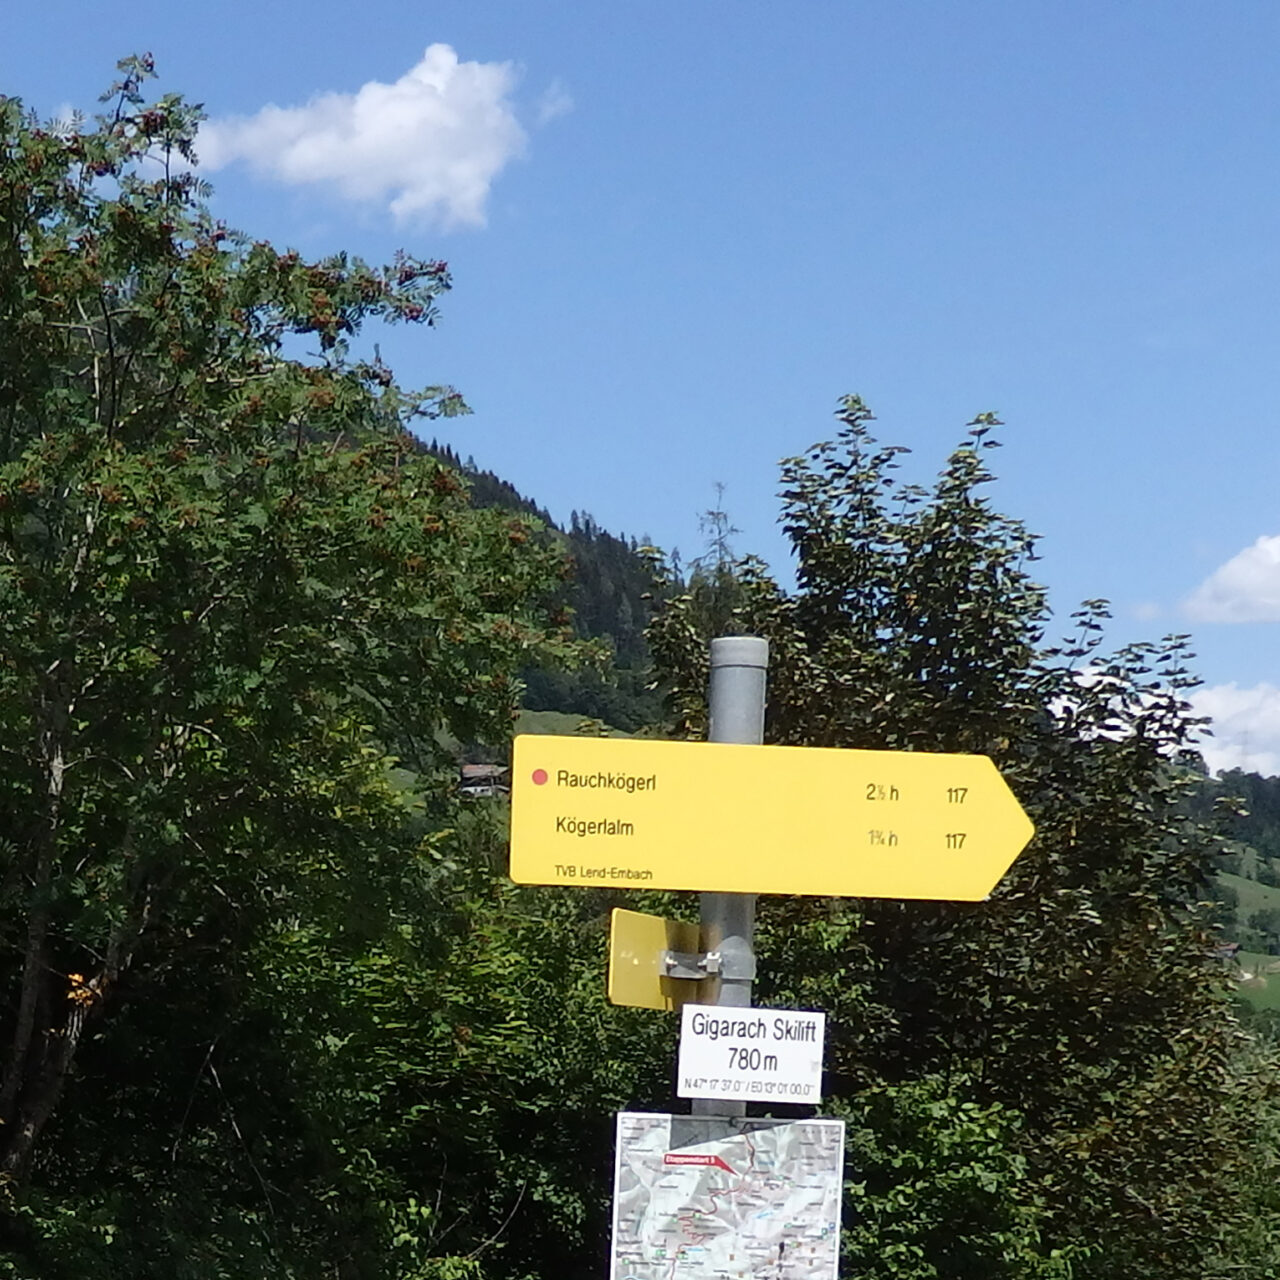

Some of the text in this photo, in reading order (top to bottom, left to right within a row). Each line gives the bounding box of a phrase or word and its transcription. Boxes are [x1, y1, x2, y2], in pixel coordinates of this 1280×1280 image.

[557, 770, 656, 794] Rauchkögerl
[889, 785, 899, 801] h
[946, 787, 968, 804] 117
[556, 816, 634, 837] Kögerlalm
[888, 830, 898, 847] h
[945, 833, 967, 849] 117
[555, 865, 653, 880] TVB Lend-Embach
[692, 1013, 816, 1042] Gigarach Skilift
